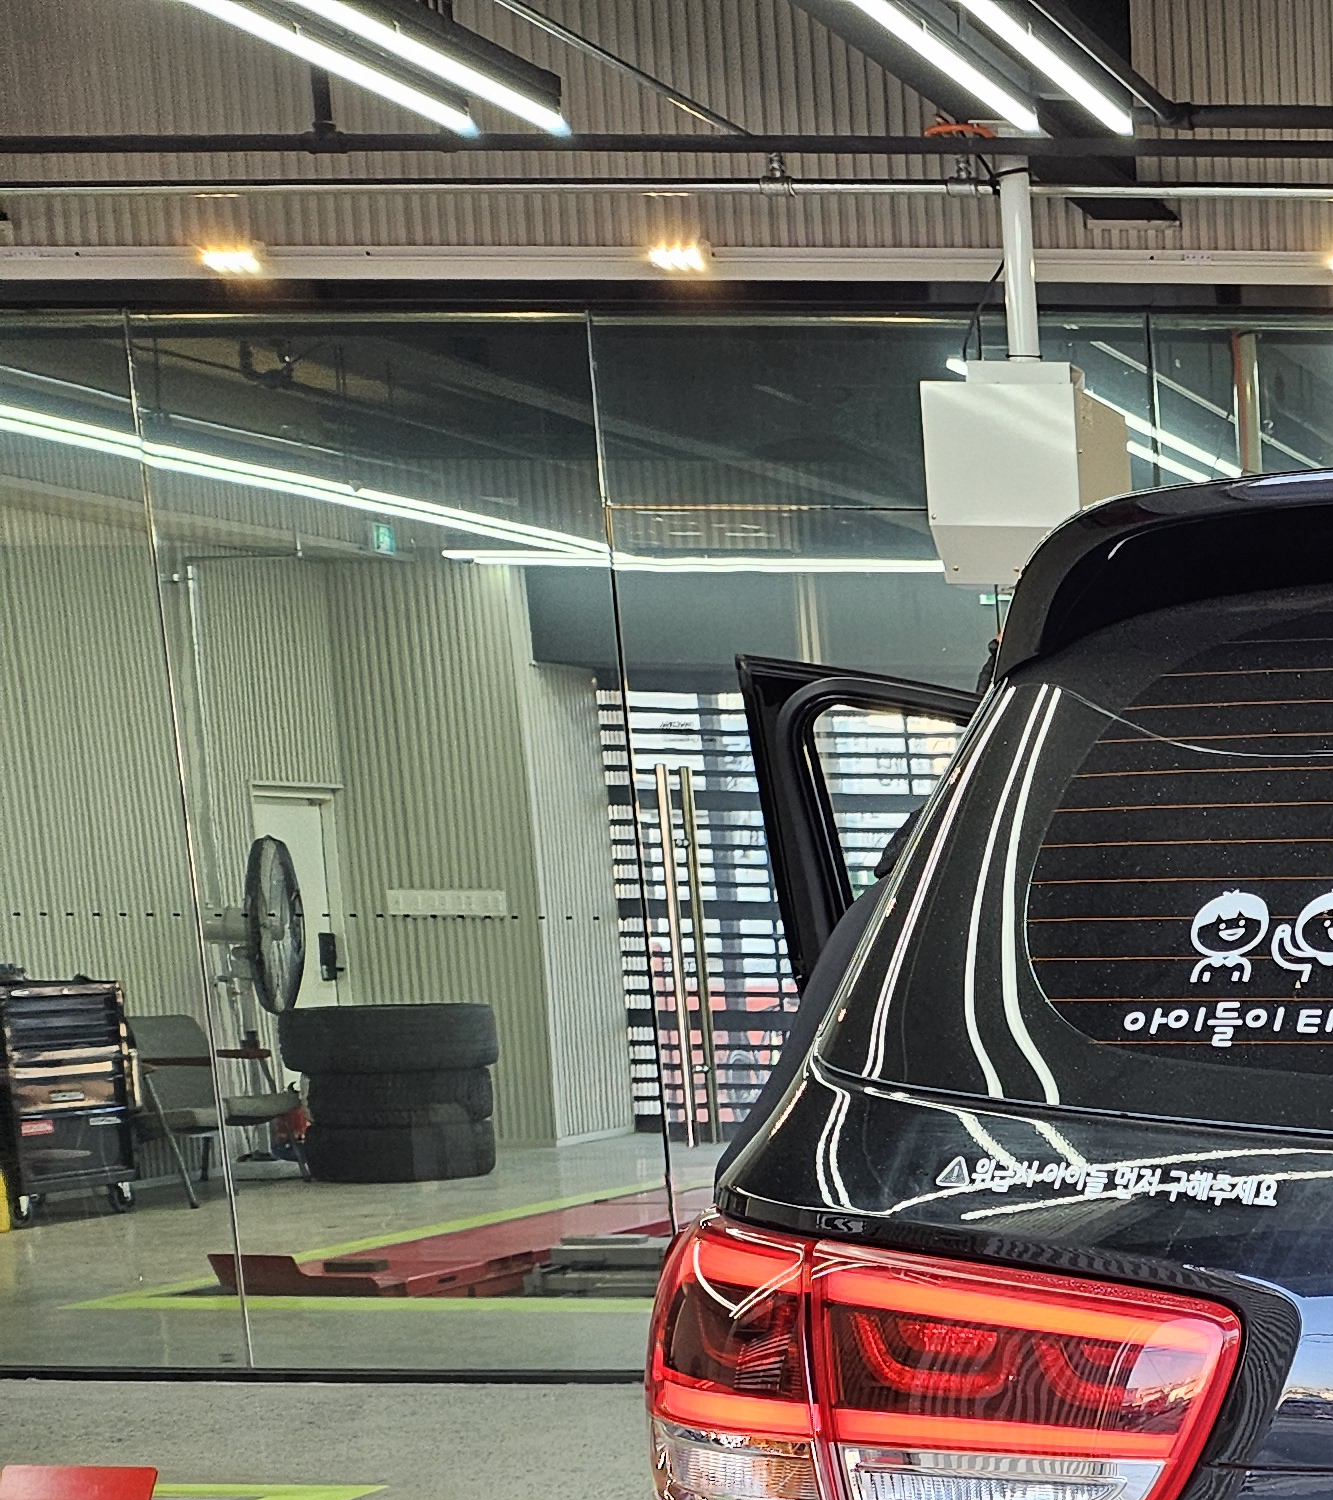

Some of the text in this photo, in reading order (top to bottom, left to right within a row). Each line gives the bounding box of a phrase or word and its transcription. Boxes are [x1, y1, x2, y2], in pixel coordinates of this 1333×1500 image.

[1123, 1001, 1286, 1048] 아이들이
[971, 1154, 1279, 1207] 위급시 아이들 먼저 구해주세요
